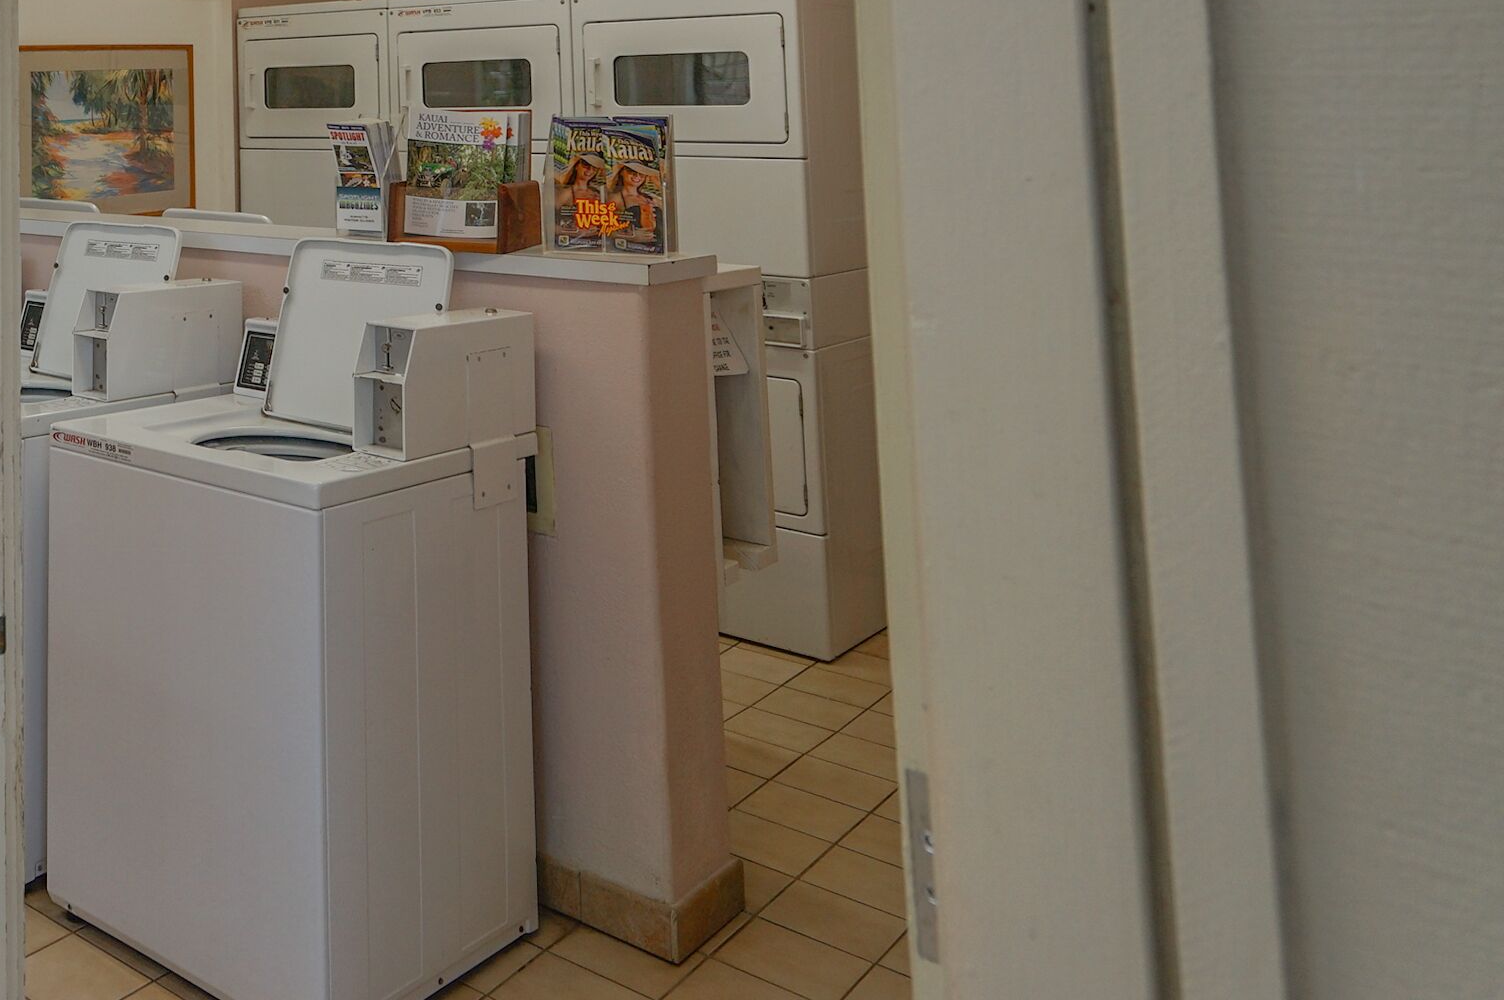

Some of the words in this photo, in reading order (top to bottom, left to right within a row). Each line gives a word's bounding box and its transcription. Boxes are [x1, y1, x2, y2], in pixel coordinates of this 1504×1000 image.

[418, 113, 448, 124] KAUAI
[416, 122, 481, 134] ADVENTURE
[330, 131, 365, 142] SPOTLIGHT
[424, 131, 480, 143] ROMANCE
[567, 129, 604, 152] Kaua
[576, 199, 608, 214] This
[576, 212, 619, 229] Week
[63, 434, 86, 447] WASH
